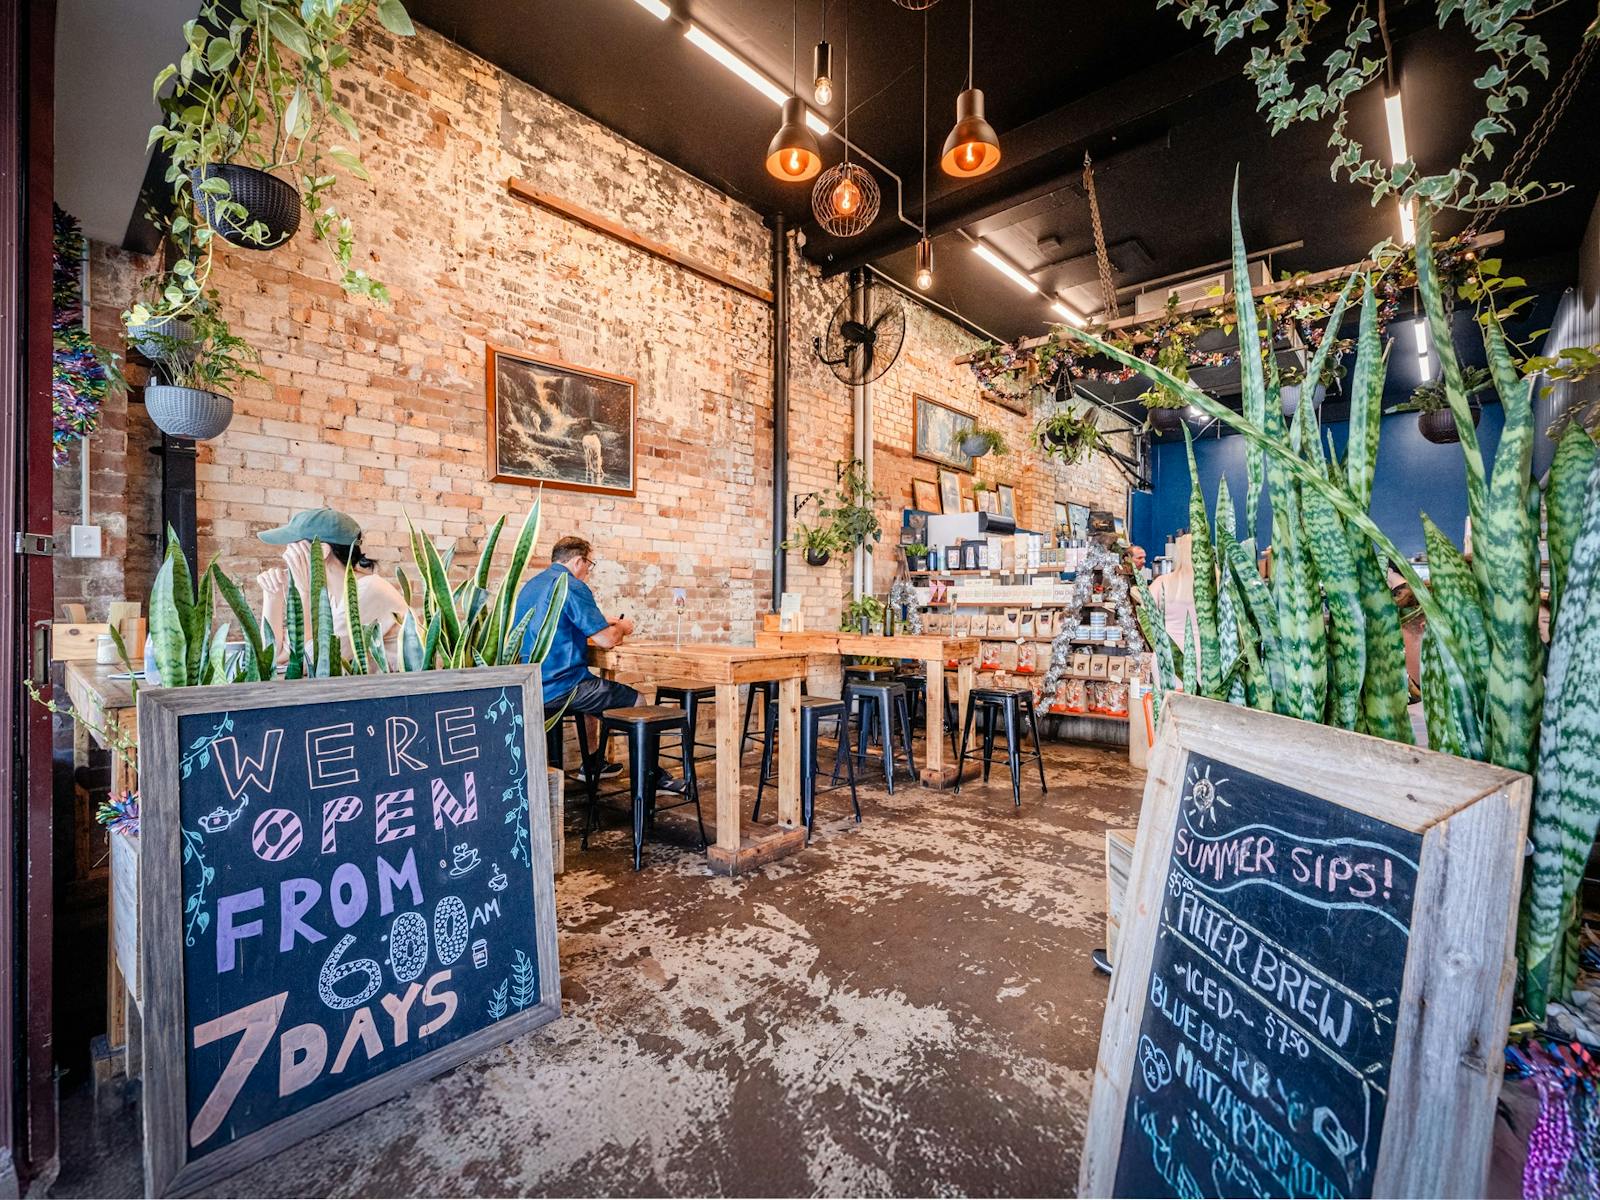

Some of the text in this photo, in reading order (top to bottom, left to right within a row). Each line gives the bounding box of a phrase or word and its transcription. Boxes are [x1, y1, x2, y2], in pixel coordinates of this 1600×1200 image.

[213, 707, 480, 799] WE'RE
[252, 772, 479, 862] OPEN
[1175, 828, 1393, 899] SUMMER SIPS!
[217, 848, 424, 974] FROM
[1178, 891, 1353, 1048] FILTER BREW
[190, 970, 458, 1148] 7 DAYS
